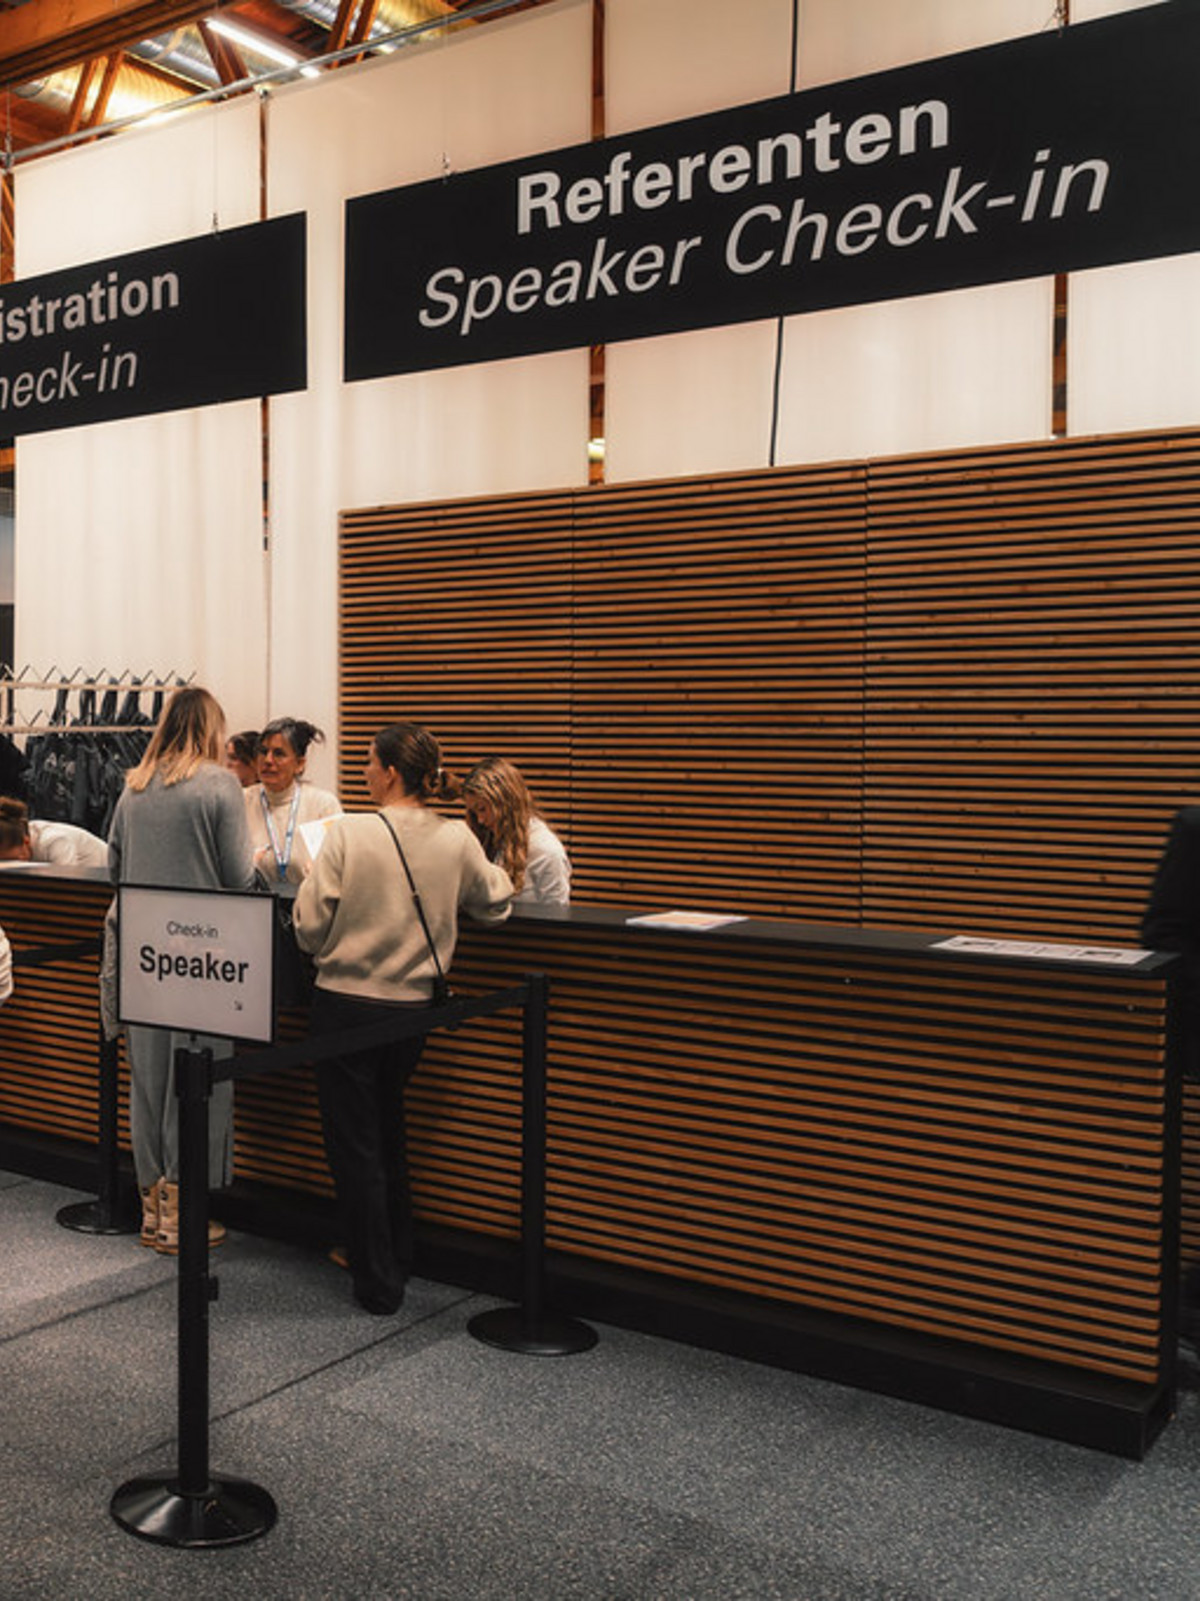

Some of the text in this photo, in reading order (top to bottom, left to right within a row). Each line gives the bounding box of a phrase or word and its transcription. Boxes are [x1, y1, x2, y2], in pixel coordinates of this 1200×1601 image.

[517, 100, 950, 235] Referenten
[418, 150, 1111, 334] Speaker Check-in
[140, 945, 248, 983] Speaker
[166, 920, 218, 939] Check-in
